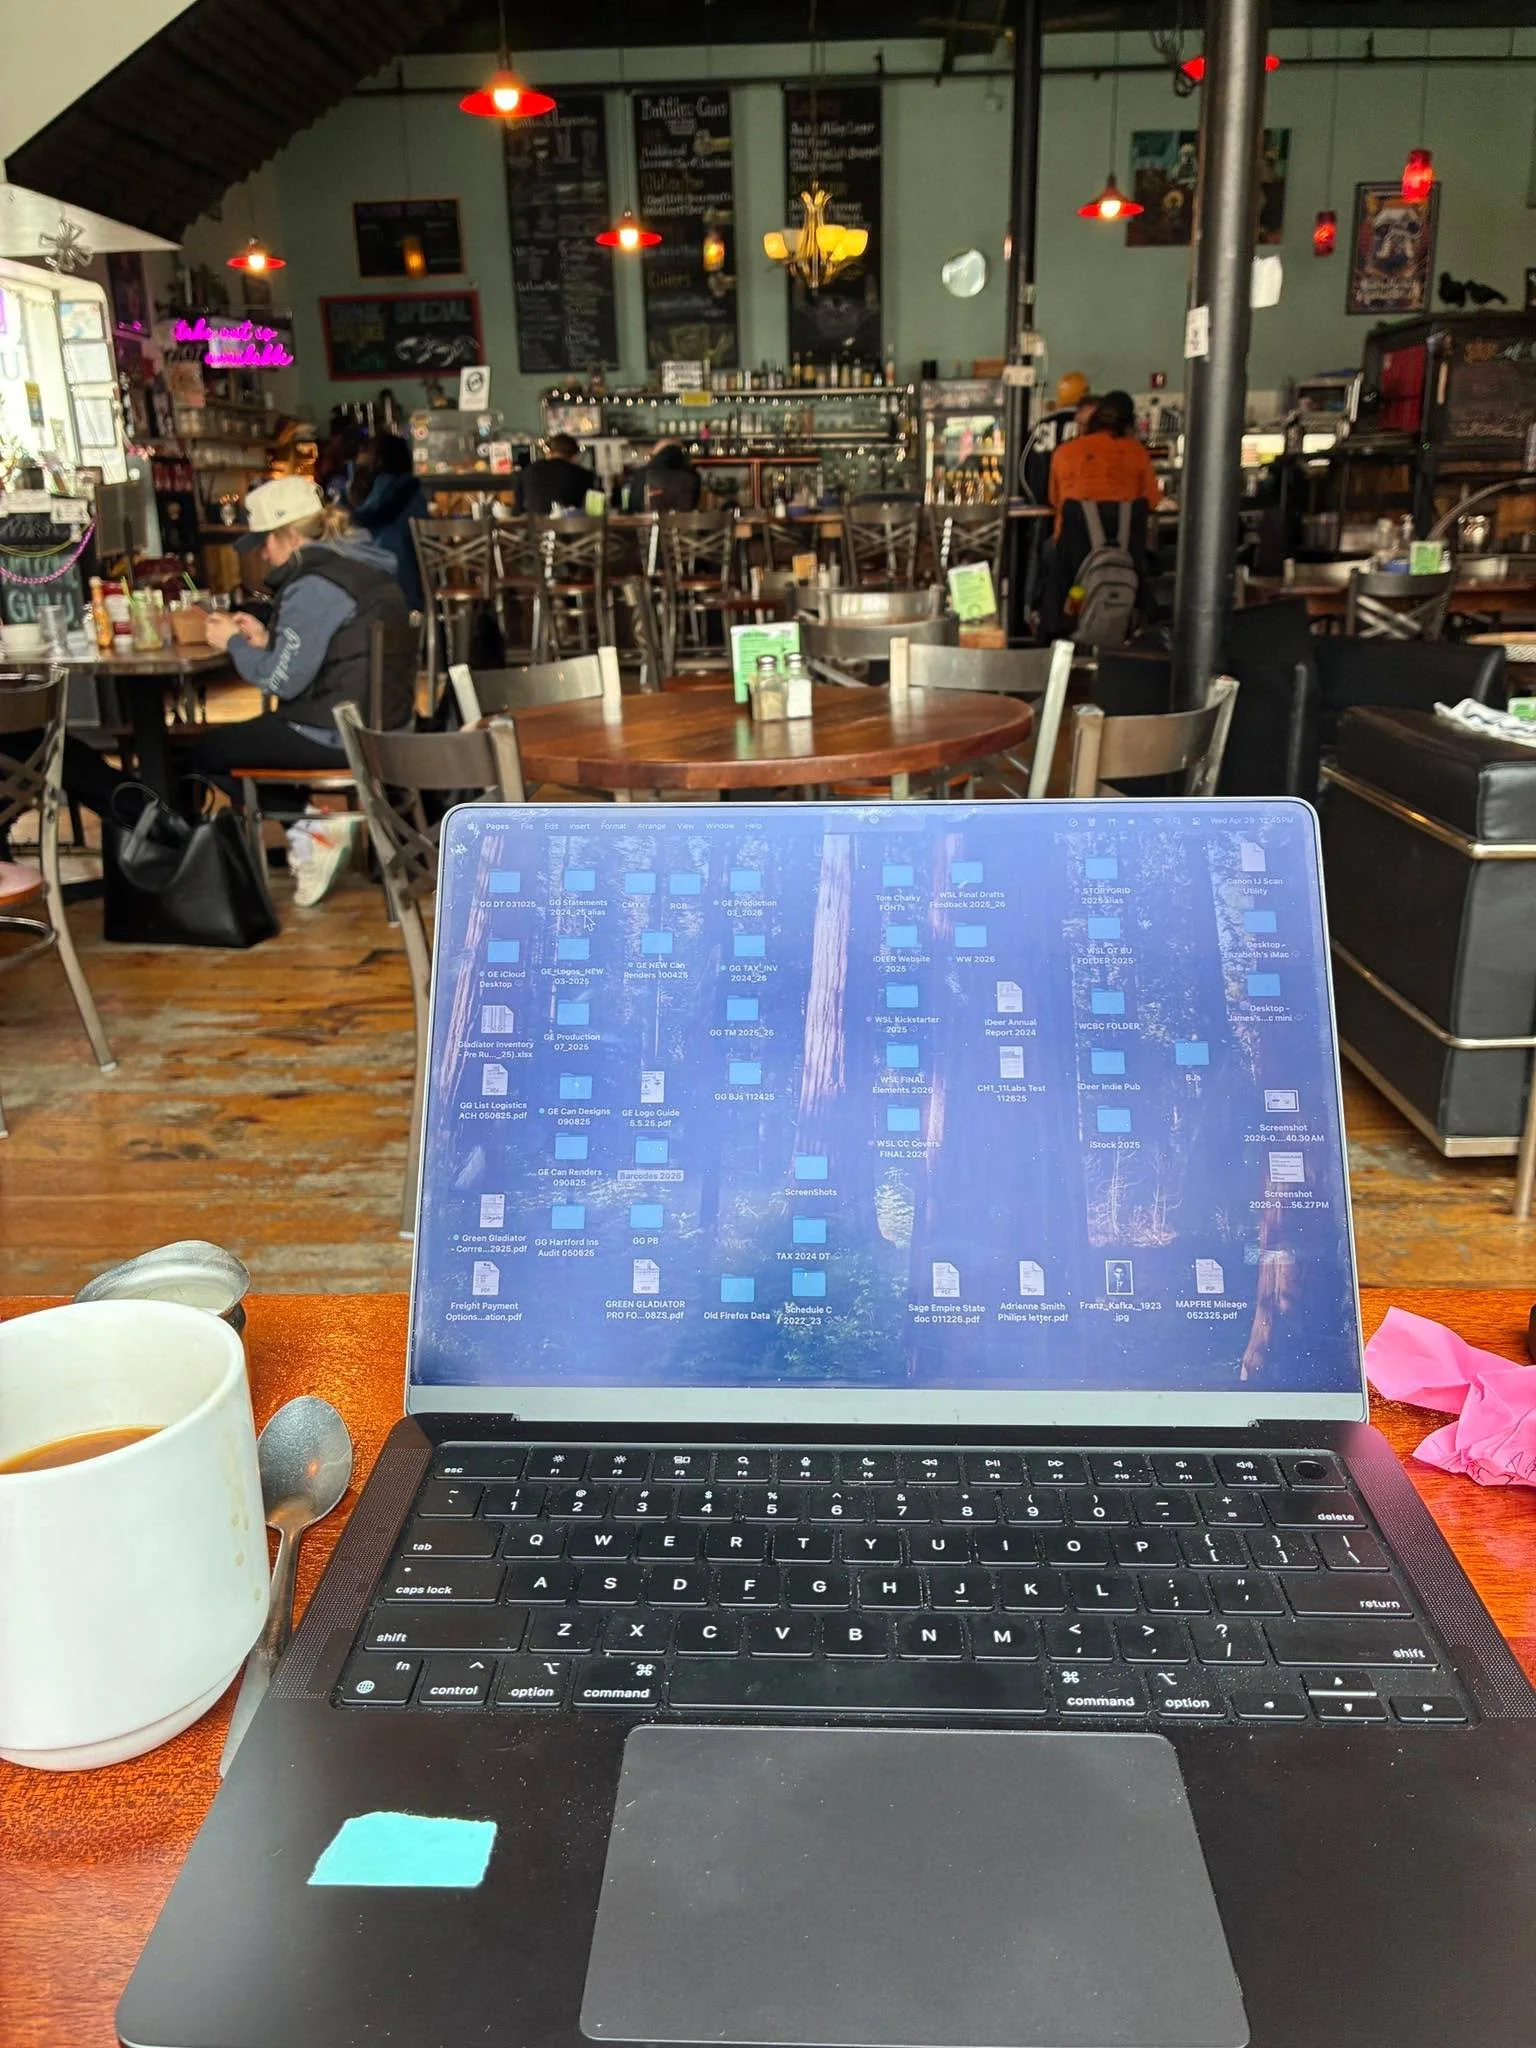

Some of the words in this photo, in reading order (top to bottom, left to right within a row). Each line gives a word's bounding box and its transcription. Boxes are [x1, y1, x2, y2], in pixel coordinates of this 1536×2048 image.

[1243, 888, 1268, 896] Utility
[1246, 941, 1281, 949] Desktop
[624, 971, 656, 979] Renders
[480, 981, 512, 989] Desktop
[1250, 1004, 1285, 1013] Desktop
[886, 1026, 907, 1034] 2025
[986, 1029, 1013, 1037] Report
[557, 1033, 600, 1041] Production
[458, 1041, 494, 1049] Gladiator
[496, 1041, 534, 1049] Inventory
[554, 1043, 589, 1051] 07_2025
[901, 1076, 925, 1084] FINAL
[873, 1086, 910, 1094] Elements
[1029, 1084, 1046, 1092] Test
[714, 1093, 727, 1101] GG
[729, 1093, 743, 1101] BJs
[746, 1093, 775, 1101] 112425
[491, 1102, 527, 1110] Logistics
[459, 1112, 477, 1120] ACH
[580, 1108, 611, 1116] Designs
[622, 1109, 633, 1117] GE
[635, 1109, 655, 1118] Logo
[656, 1109, 680, 1117] Guide
[1259, 1124, 1308, 1132] Screenshot
[876, 1140, 896, 1148] WSL
[897, 1140, 910, 1148] CC
[912, 1140, 941, 1148] Covers
[1090, 1141, 1116, 1149] iStock
[1117, 1141, 1141, 1149] 2025
[880, 1150, 904, 1158] FINAL
[553, 1179, 586, 1187] 090825
[785, 1188, 837, 1196] ScreenShots
[1264, 1190, 1313, 1198] Screenshot
[489, 1234, 527, 1242] Gladiator
[549, 1238, 584, 1246] Hartford
[633, 1237, 645, 1245] GG
[648, 1237, 659, 1245] PB
[451, 1302, 480, 1311] Freight
[482, 1302, 519, 1311] Payment
[605, 1300, 634, 1308] GREEN
[636, 1300, 686, 1308] GLADIATOR
[908, 1304, 930, 1313] Sage
[931, 1304, 961, 1313] Empire
[962, 1304, 986, 1312] State
[1000, 1302, 1039, 1310] Adrienne
[1041, 1302, 1066, 1310] Smith
[1175, 1300, 1212, 1308] MAPFRE
[1213, 1300, 1248, 1310] Mileage
[785, 1305, 824, 1314] Schedule
[704, 1311, 719, 1320] Old
[720, 1311, 749, 1320] Firefox
[750, 1311, 770, 1320] Data
[914, 1315, 930, 1323] doc
[998, 1313, 1027, 1322] Philips
[1028, 1313, 1069, 1322] letter.pdf
[783, 1317, 822, 1326] 2022_23
[444, 1466, 464, 1474] esc
[510, 1502, 518, 1511] 1
[572, 1502, 584, 1512] 2
[636, 1502, 648, 1513] 3
[701, 1503, 713, 1513] 4
[766, 1504, 778, 1514] 5
[831, 1505, 843, 1515] 6
[897, 1506, 907, 1516] 7
[962, 1506, 973, 1517] 8
[1027, 1506, 1039, 1518] 9
[1093, 1506, 1106, 1518] 0
[1317, 1512, 1355, 1522] delete
[529, 1534, 544, 1546] Q
[595, 1535, 613, 1545] W
[664, 1536, 675, 1547] E
[730, 1537, 743, 1548] R
[797, 1537, 810, 1548] T
[864, 1538, 877, 1549] Y
[931, 1539, 945, 1550] U
[412, 1543, 432, 1551] tab
[1067, 1540, 1081, 1552] O
[1136, 1541, 1149, 1552] P
[534, 1577, 548, 1588] A
[604, 1578, 617, 1589] S
[673, 1579, 687, 1591] D
[744, 1580, 756, 1591] F
[812, 1581, 827, 1593] G
[883, 1582, 897, 1593] H
[395, 1586, 424, 1596] caps
[427, 1585, 452, 1594] lock
[954, 1583, 966, 1594] J
[1025, 1584, 1039, 1596] K
[1096, 1585, 1109, 1597] L
[1360, 1598, 1400, 1609] return
[557, 1624, 571, 1636] Z
[630, 1625, 645, 1637] X
[702, 1626, 717, 1638] C
[775, 1627, 790, 1639] V
[849, 1628, 863, 1641] B
[377, 1632, 407, 1643] shift
[922, 1630, 937, 1642] N
[993, 1630, 1011, 1643] M
[1393, 1648, 1426, 1660] shift
[396, 1661, 410, 1671] fn
[430, 1685, 478, 1696] control
[511, 1687, 554, 1698] option
[583, 1688, 650, 1698] command
[1067, 1696, 1135, 1708] command
[1165, 1697, 1210, 1711] option
